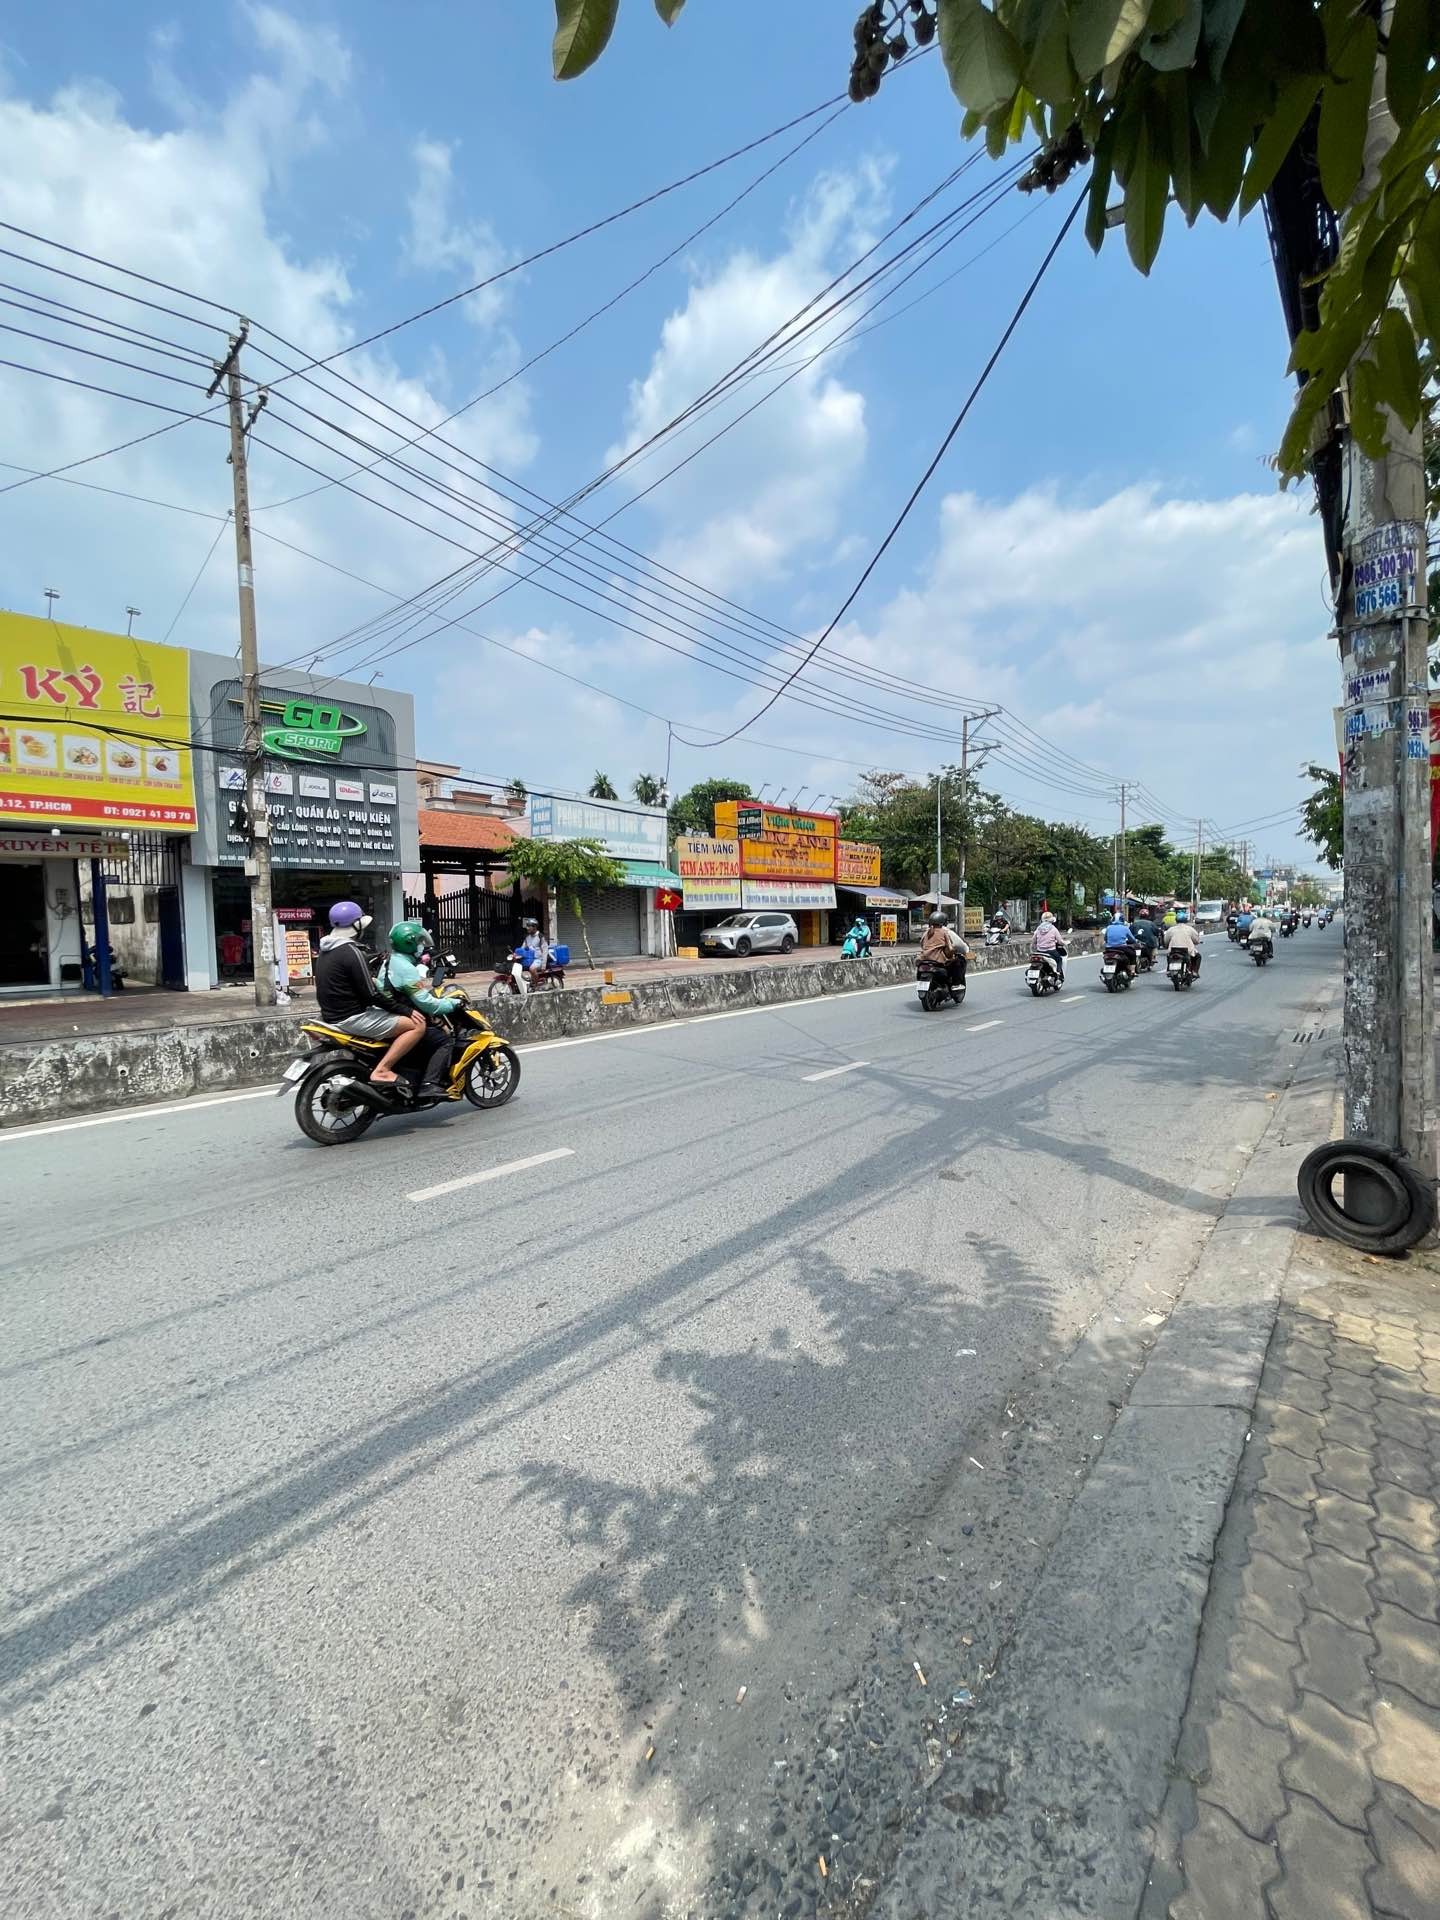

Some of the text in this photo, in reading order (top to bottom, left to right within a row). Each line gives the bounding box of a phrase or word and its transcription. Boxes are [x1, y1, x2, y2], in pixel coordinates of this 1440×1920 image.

[20, 665, 102, 708] KÝ
[118, 676, 161, 718] 記
[283, 700, 341, 730] GO
[285, 733, 337, 750] SPORT
[339, 786, 360, 794] Wilson
[29, 800, 72, 811] TP.HCM
[122, 808, 146, 817] 0921
[150, 810, 161, 818] 41
[266, 804, 285, 817] VỢT
[326, 806, 340, 820] ÁO
[349, 810, 368, 824] PHỤ
[369, 811, 391, 827] KIỆN
[680, 860, 698, 876] KIM
